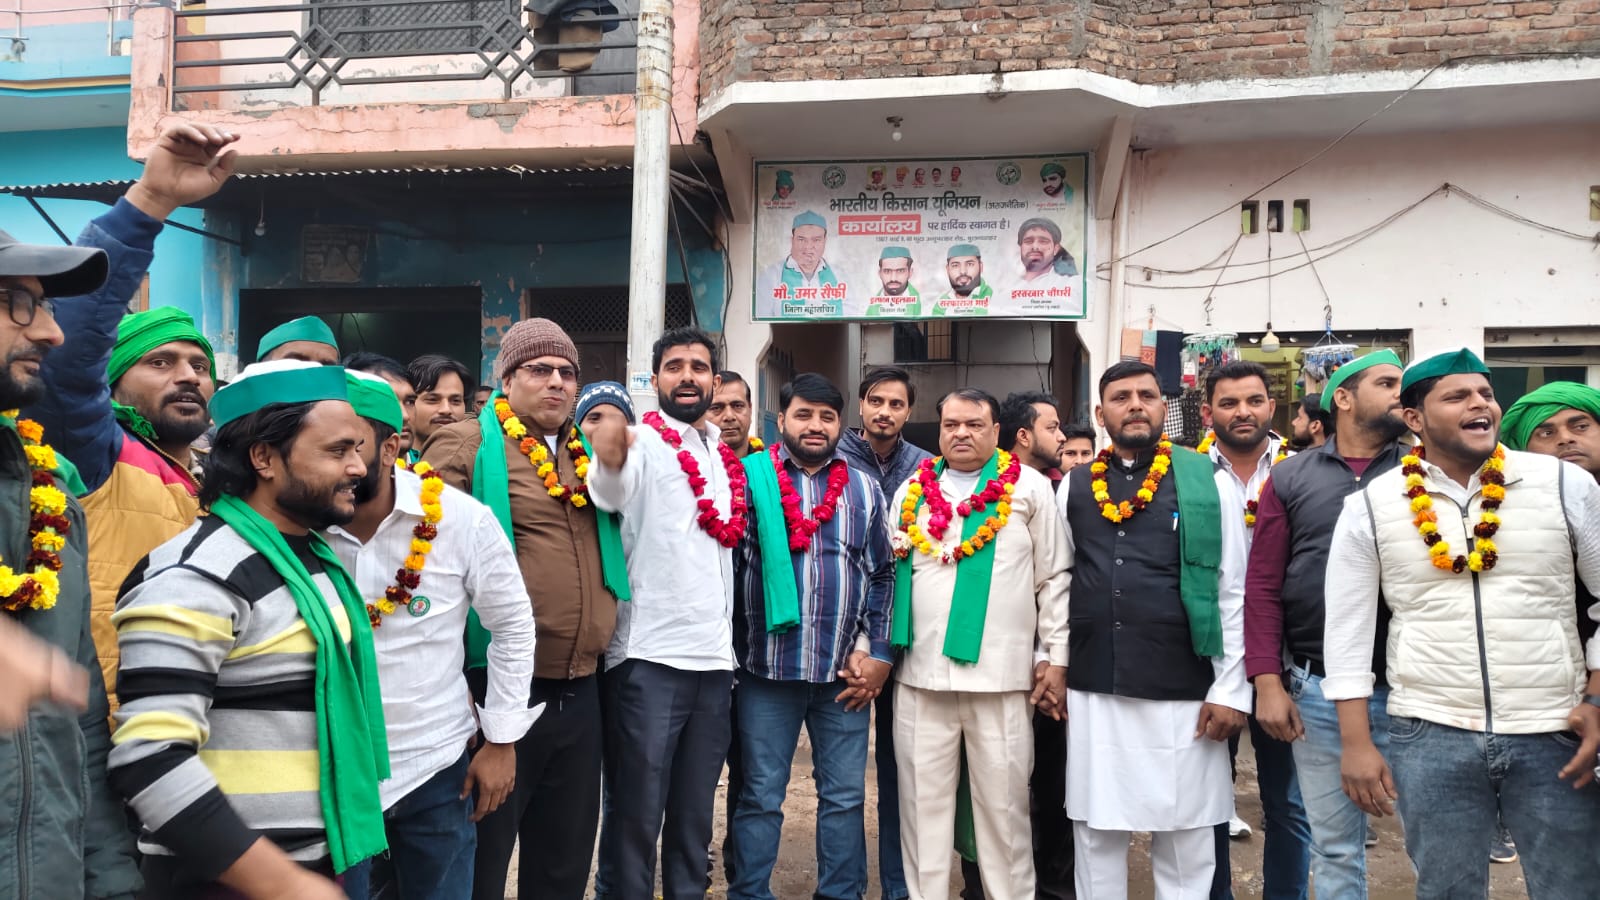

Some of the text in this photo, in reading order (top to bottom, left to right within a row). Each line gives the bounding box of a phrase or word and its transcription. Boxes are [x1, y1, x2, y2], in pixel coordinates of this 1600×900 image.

[830, 191, 878, 212] भारतीय
[882, 191, 928, 212] किसान
[932, 190, 981, 216] यूनियन
[841, 216, 918, 233] कार्यालय
[928, 222, 939, 231] पर
[940, 218, 967, 231] हार्दिक
[969, 219, 997, 230] स्वागत
[795, 288, 817, 299] उमर
[820, 283, 846, 299] सैफी
[784, 303, 803, 313] जिला
